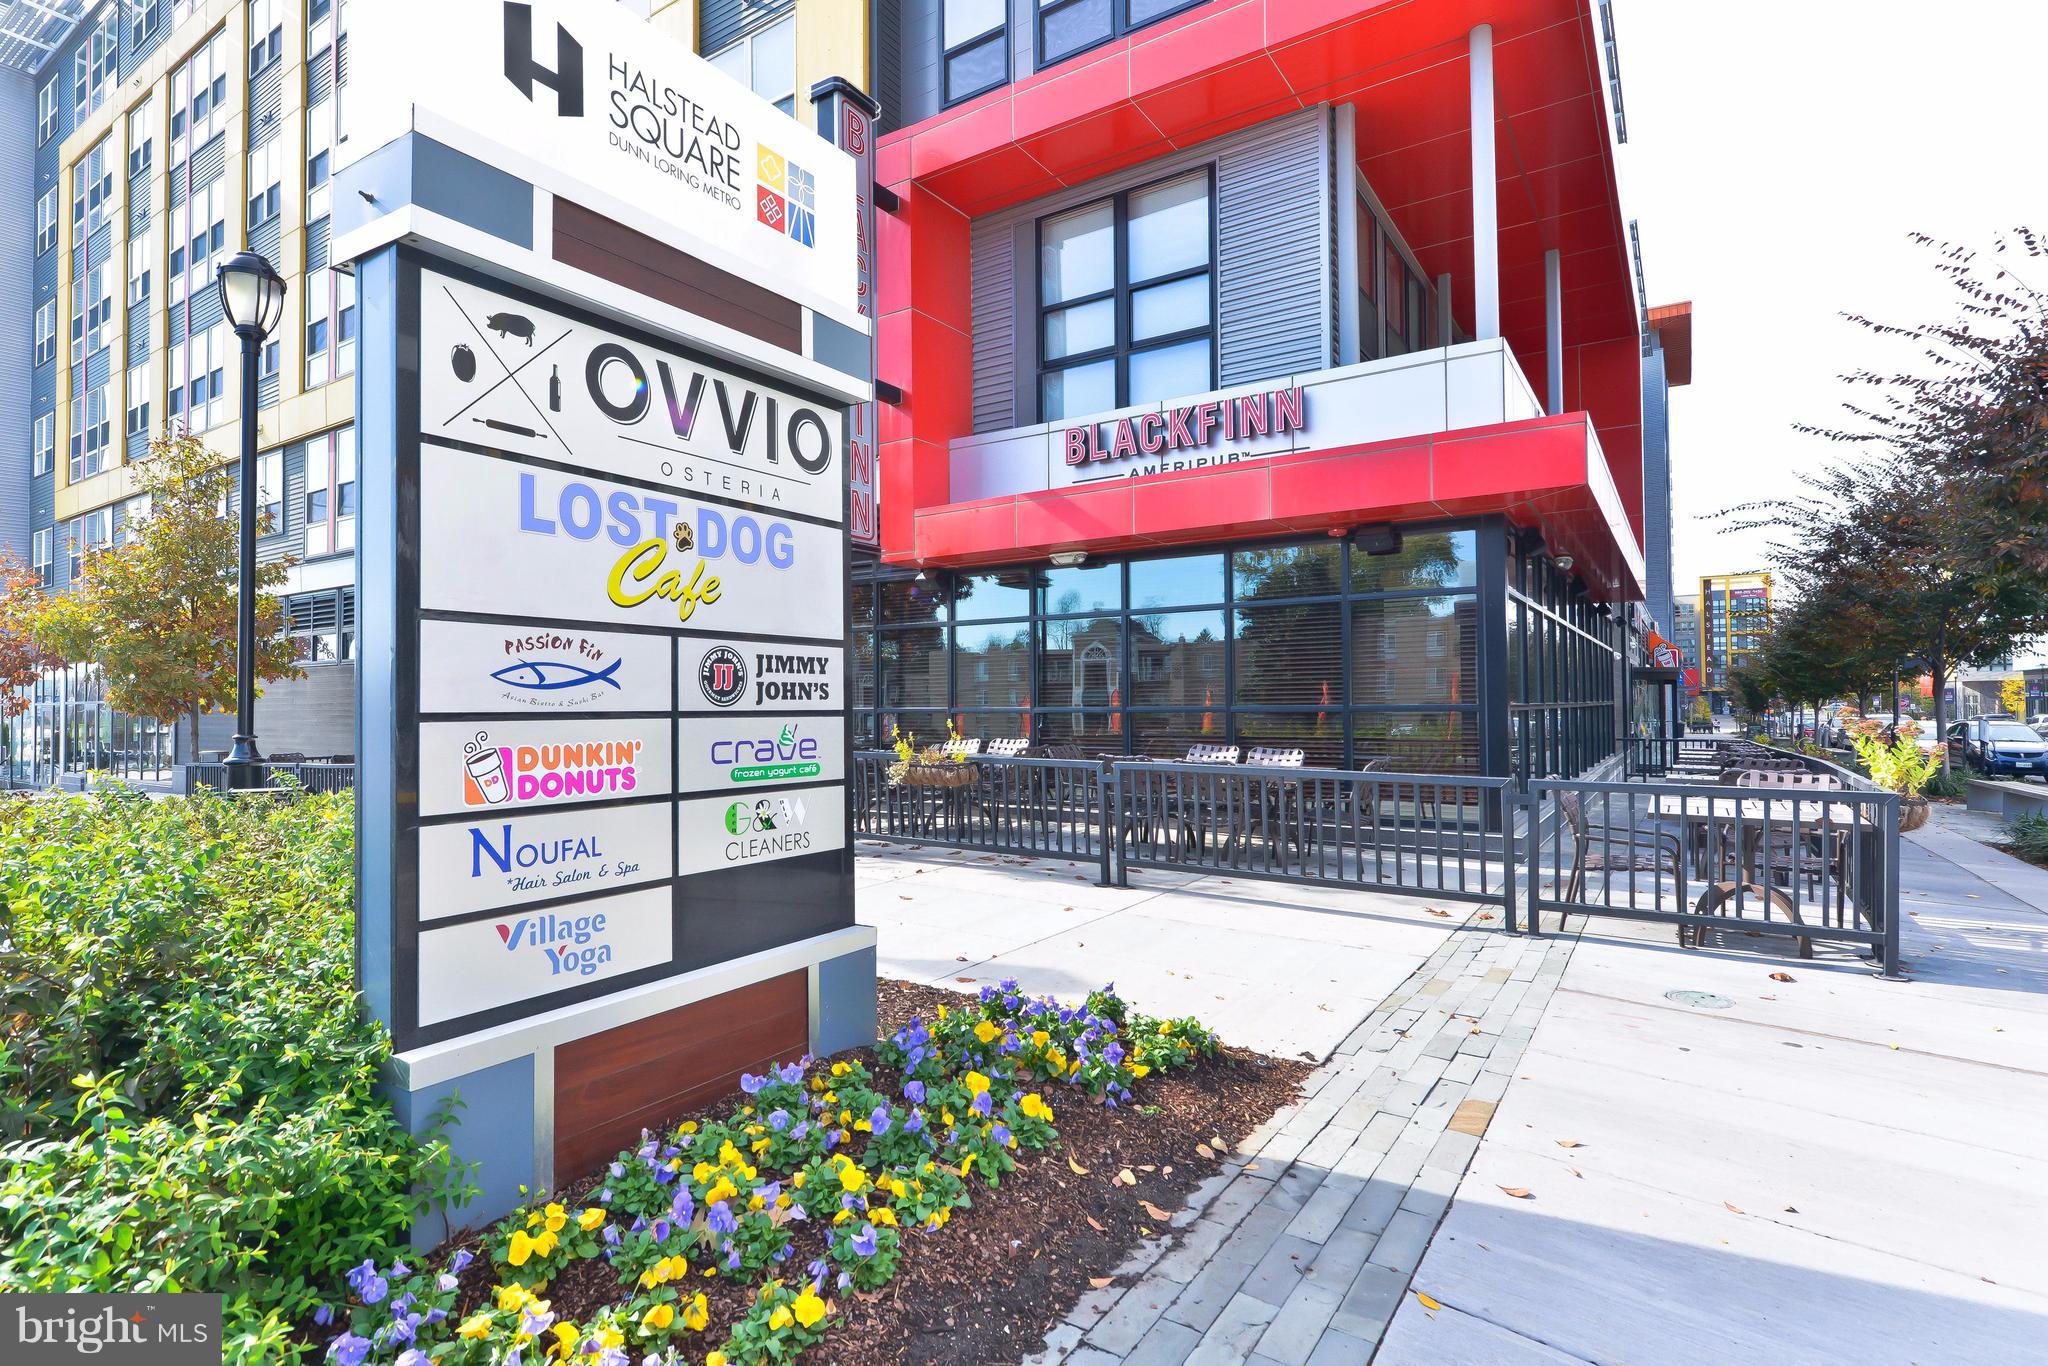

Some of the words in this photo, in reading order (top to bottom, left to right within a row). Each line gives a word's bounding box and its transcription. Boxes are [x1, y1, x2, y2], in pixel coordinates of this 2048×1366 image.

[609, 52, 740, 151] HALSTEAD
[609, 90, 740, 192] SQUARE
[609, 131, 650, 164] DUNN
[654, 153, 700, 189] LORING
[703, 182, 741, 211] METRO
[585, 342, 832, 475] OVVIO
[1065, 386, 1304, 466] BLACKFINN
[661, 461, 781, 501] OSTERIA
[518, 471, 678, 547] LOST
[696, 505, 795, 571] DOG
[607, 537, 722, 622] Cafe
[1704, 589, 1712, 673] HALSTEAD
[703, 651, 722, 677] JIMMY
[713, 663, 734, 690] JJ
[755, 653, 829, 676] JIMMY
[501, 691, 526, 704] Asian
[567, 697, 589, 707] Sushi
[591, 691, 605, 701] Bar
[755, 682, 830, 705] JOHN'S
[517, 741, 642, 772] DUNKIN'
[711, 738, 817, 764] crave
[484, 775, 499, 787] DD
[517, 766, 636, 800] DONUTS
[734, 769, 765, 778] frozen
[768, 766, 796, 777] yogurt
[468, 824, 603, 878] NOUFAL
[725, 831, 811, 861] CLEANERS
[552, 869, 592, 886] Salon
[598, 864, 609, 877] &
[615, 861, 640, 877] Spa
[495, 913, 606, 951] Village
[544, 944, 612, 976] Yoga
